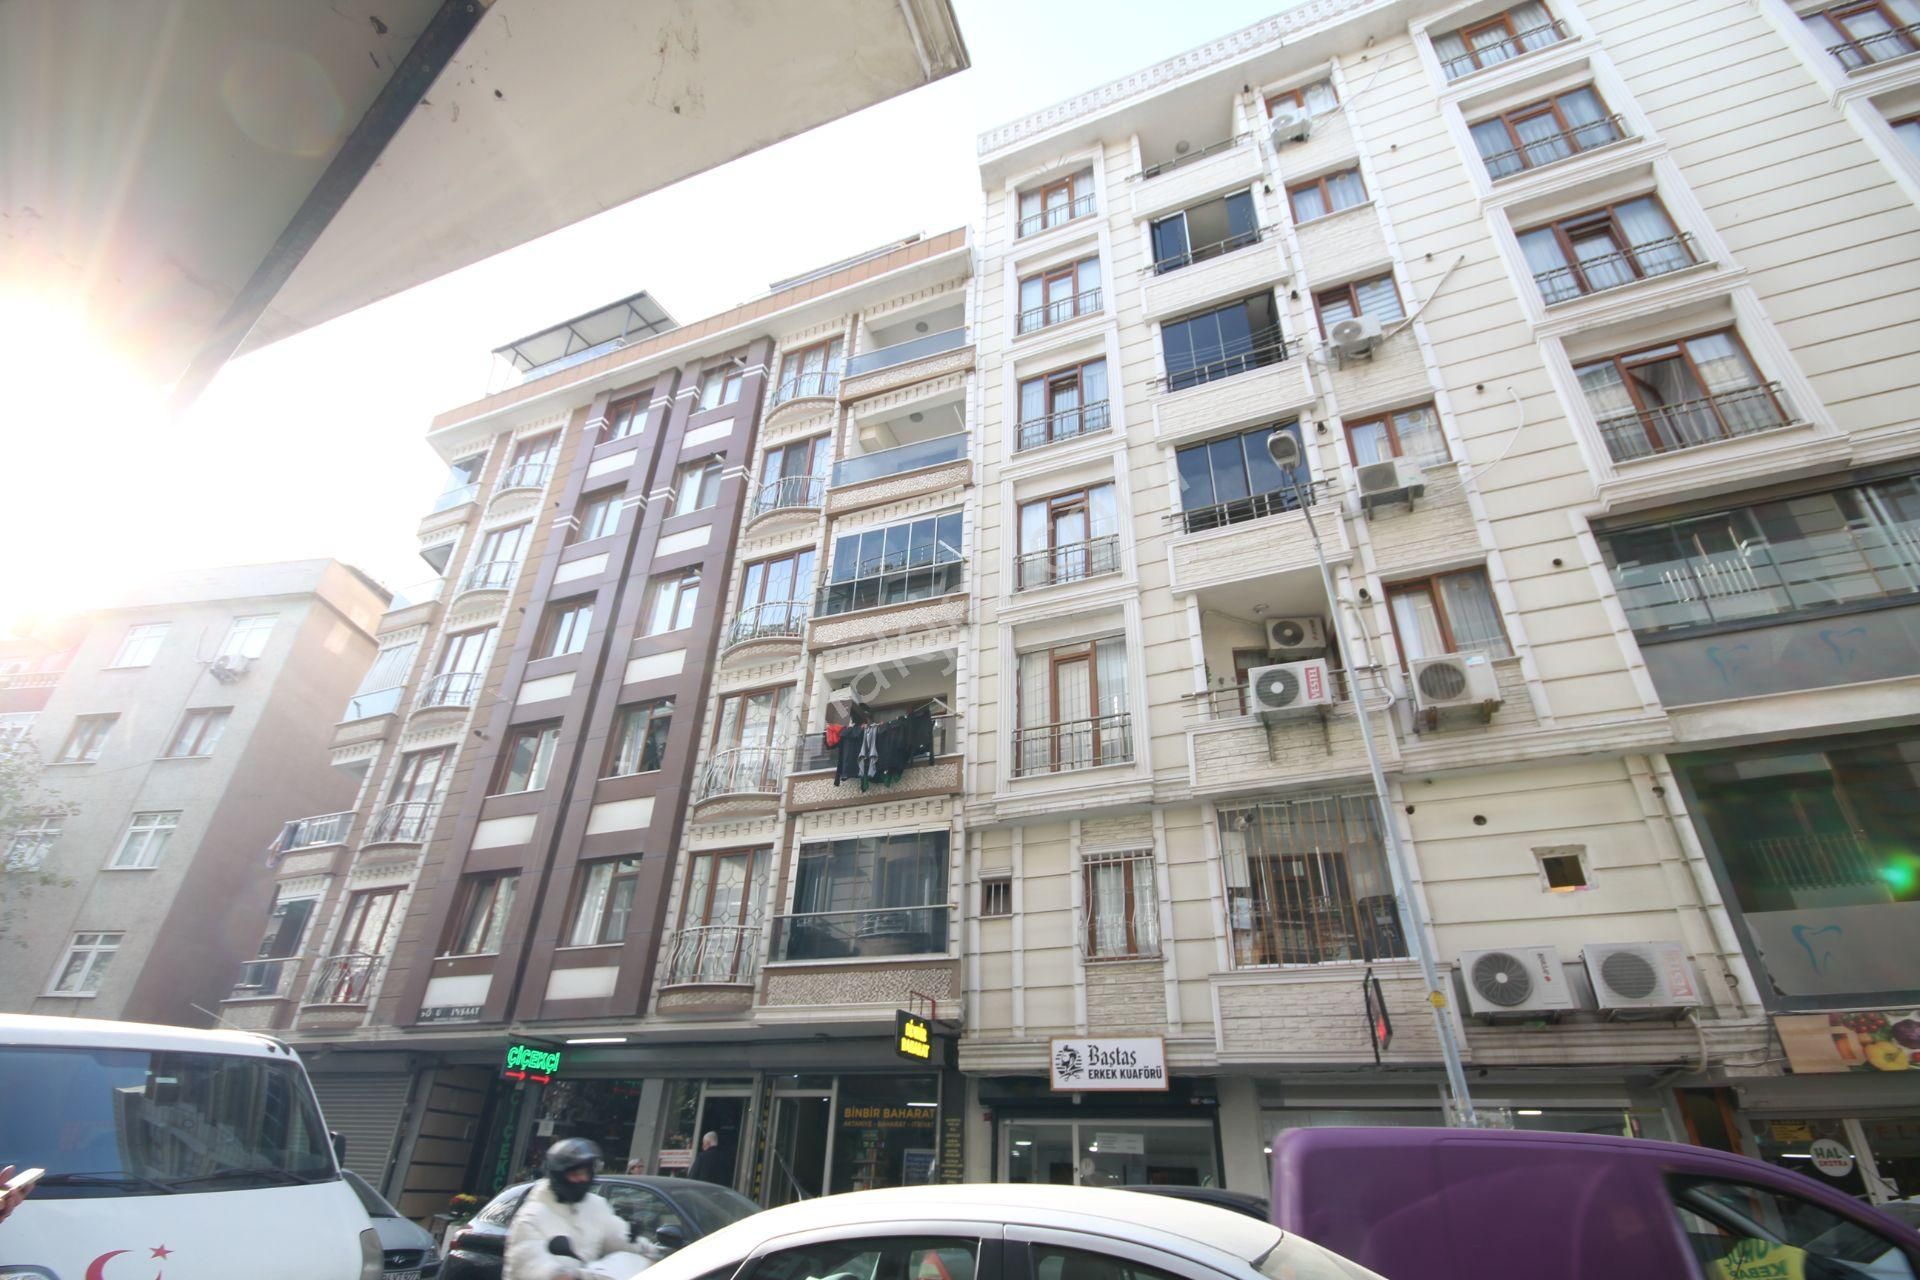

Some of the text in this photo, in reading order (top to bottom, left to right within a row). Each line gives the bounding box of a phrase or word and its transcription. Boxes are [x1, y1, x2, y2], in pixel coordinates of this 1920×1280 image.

[1307, 666, 1321, 699] VESTEL
[507, 1045, 561, 1075] ÇİÇEKÇİ
[1088, 1044, 1136, 1068] Baştaş
[1088, 1066, 1162, 1080] ERKEK KUAFÖRÜ
[843, 1105, 936, 1119] BİNBİR BAHARAT
[1813, 1147, 1843, 1160] HAL
